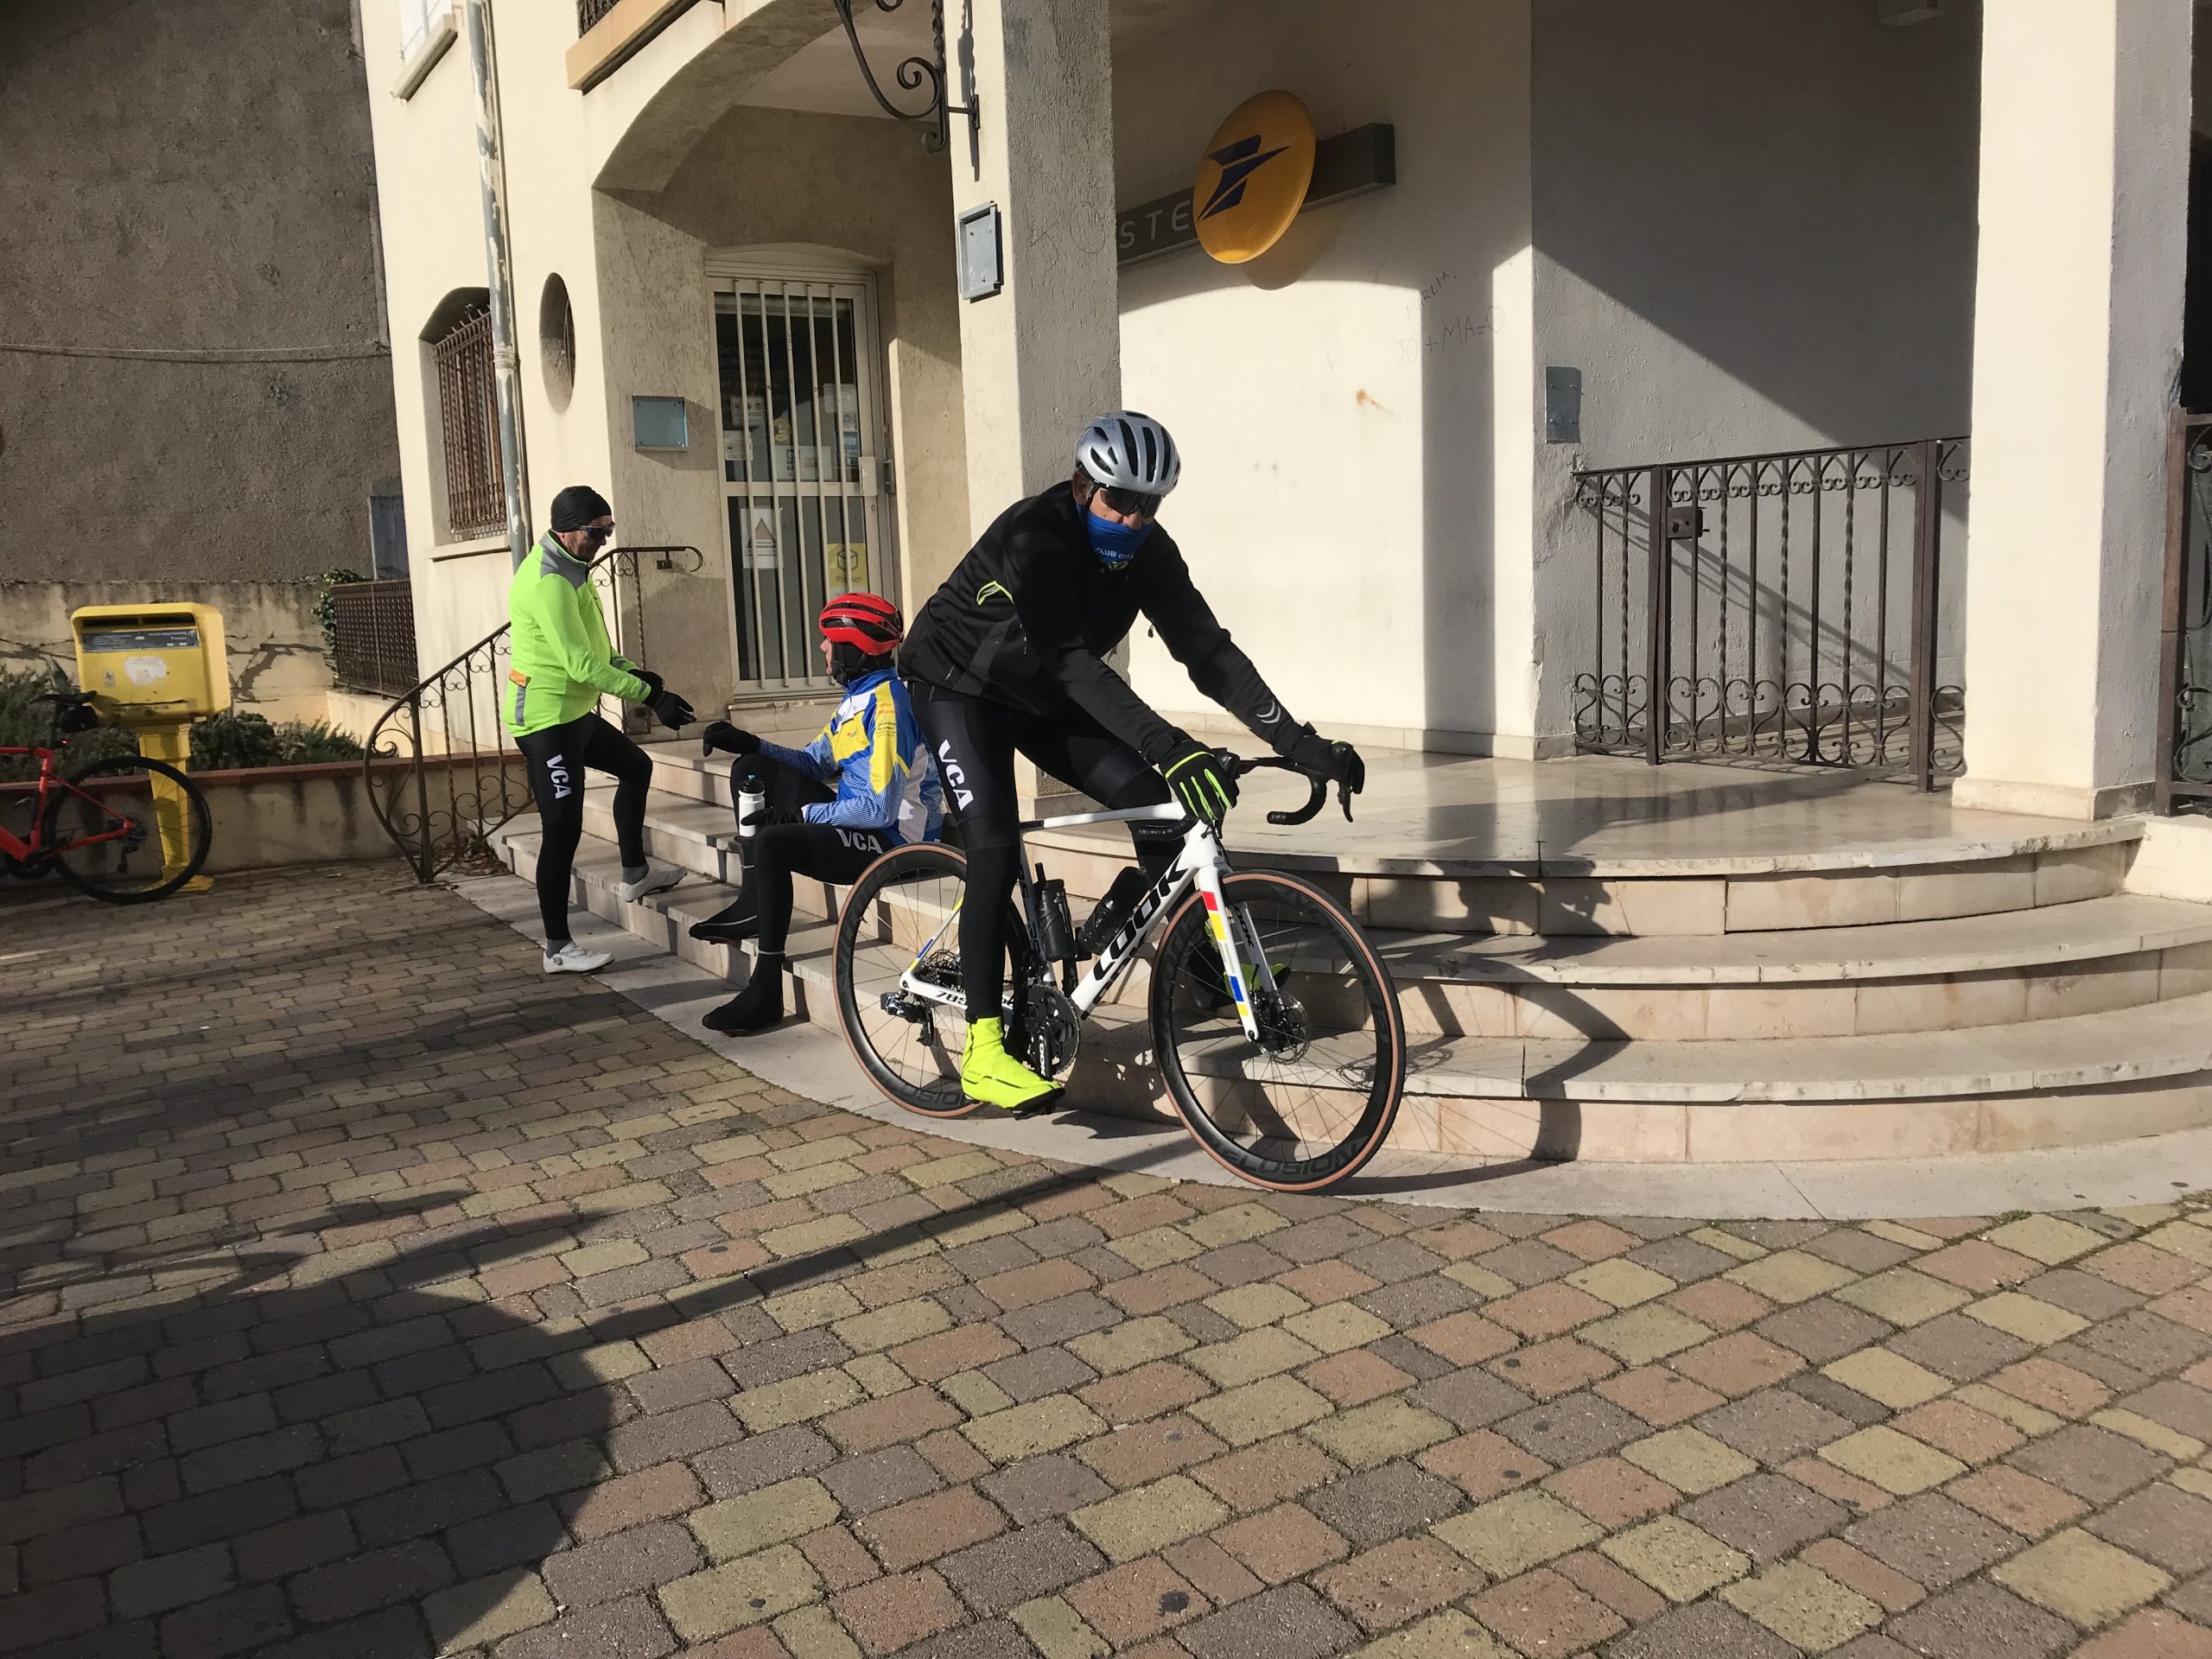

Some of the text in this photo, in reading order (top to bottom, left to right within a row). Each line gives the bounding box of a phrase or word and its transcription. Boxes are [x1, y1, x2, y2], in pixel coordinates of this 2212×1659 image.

[1095, 547, 1116, 557] CLUB
[836, 575, 861, 584] Picup
[546, 753, 572, 799] VCA
[938, 739, 974, 812] VCA
[835, 828, 884, 854] VCA
[1093, 854, 1189, 981] LOOK
[1233, 905, 1255, 948] OOK
